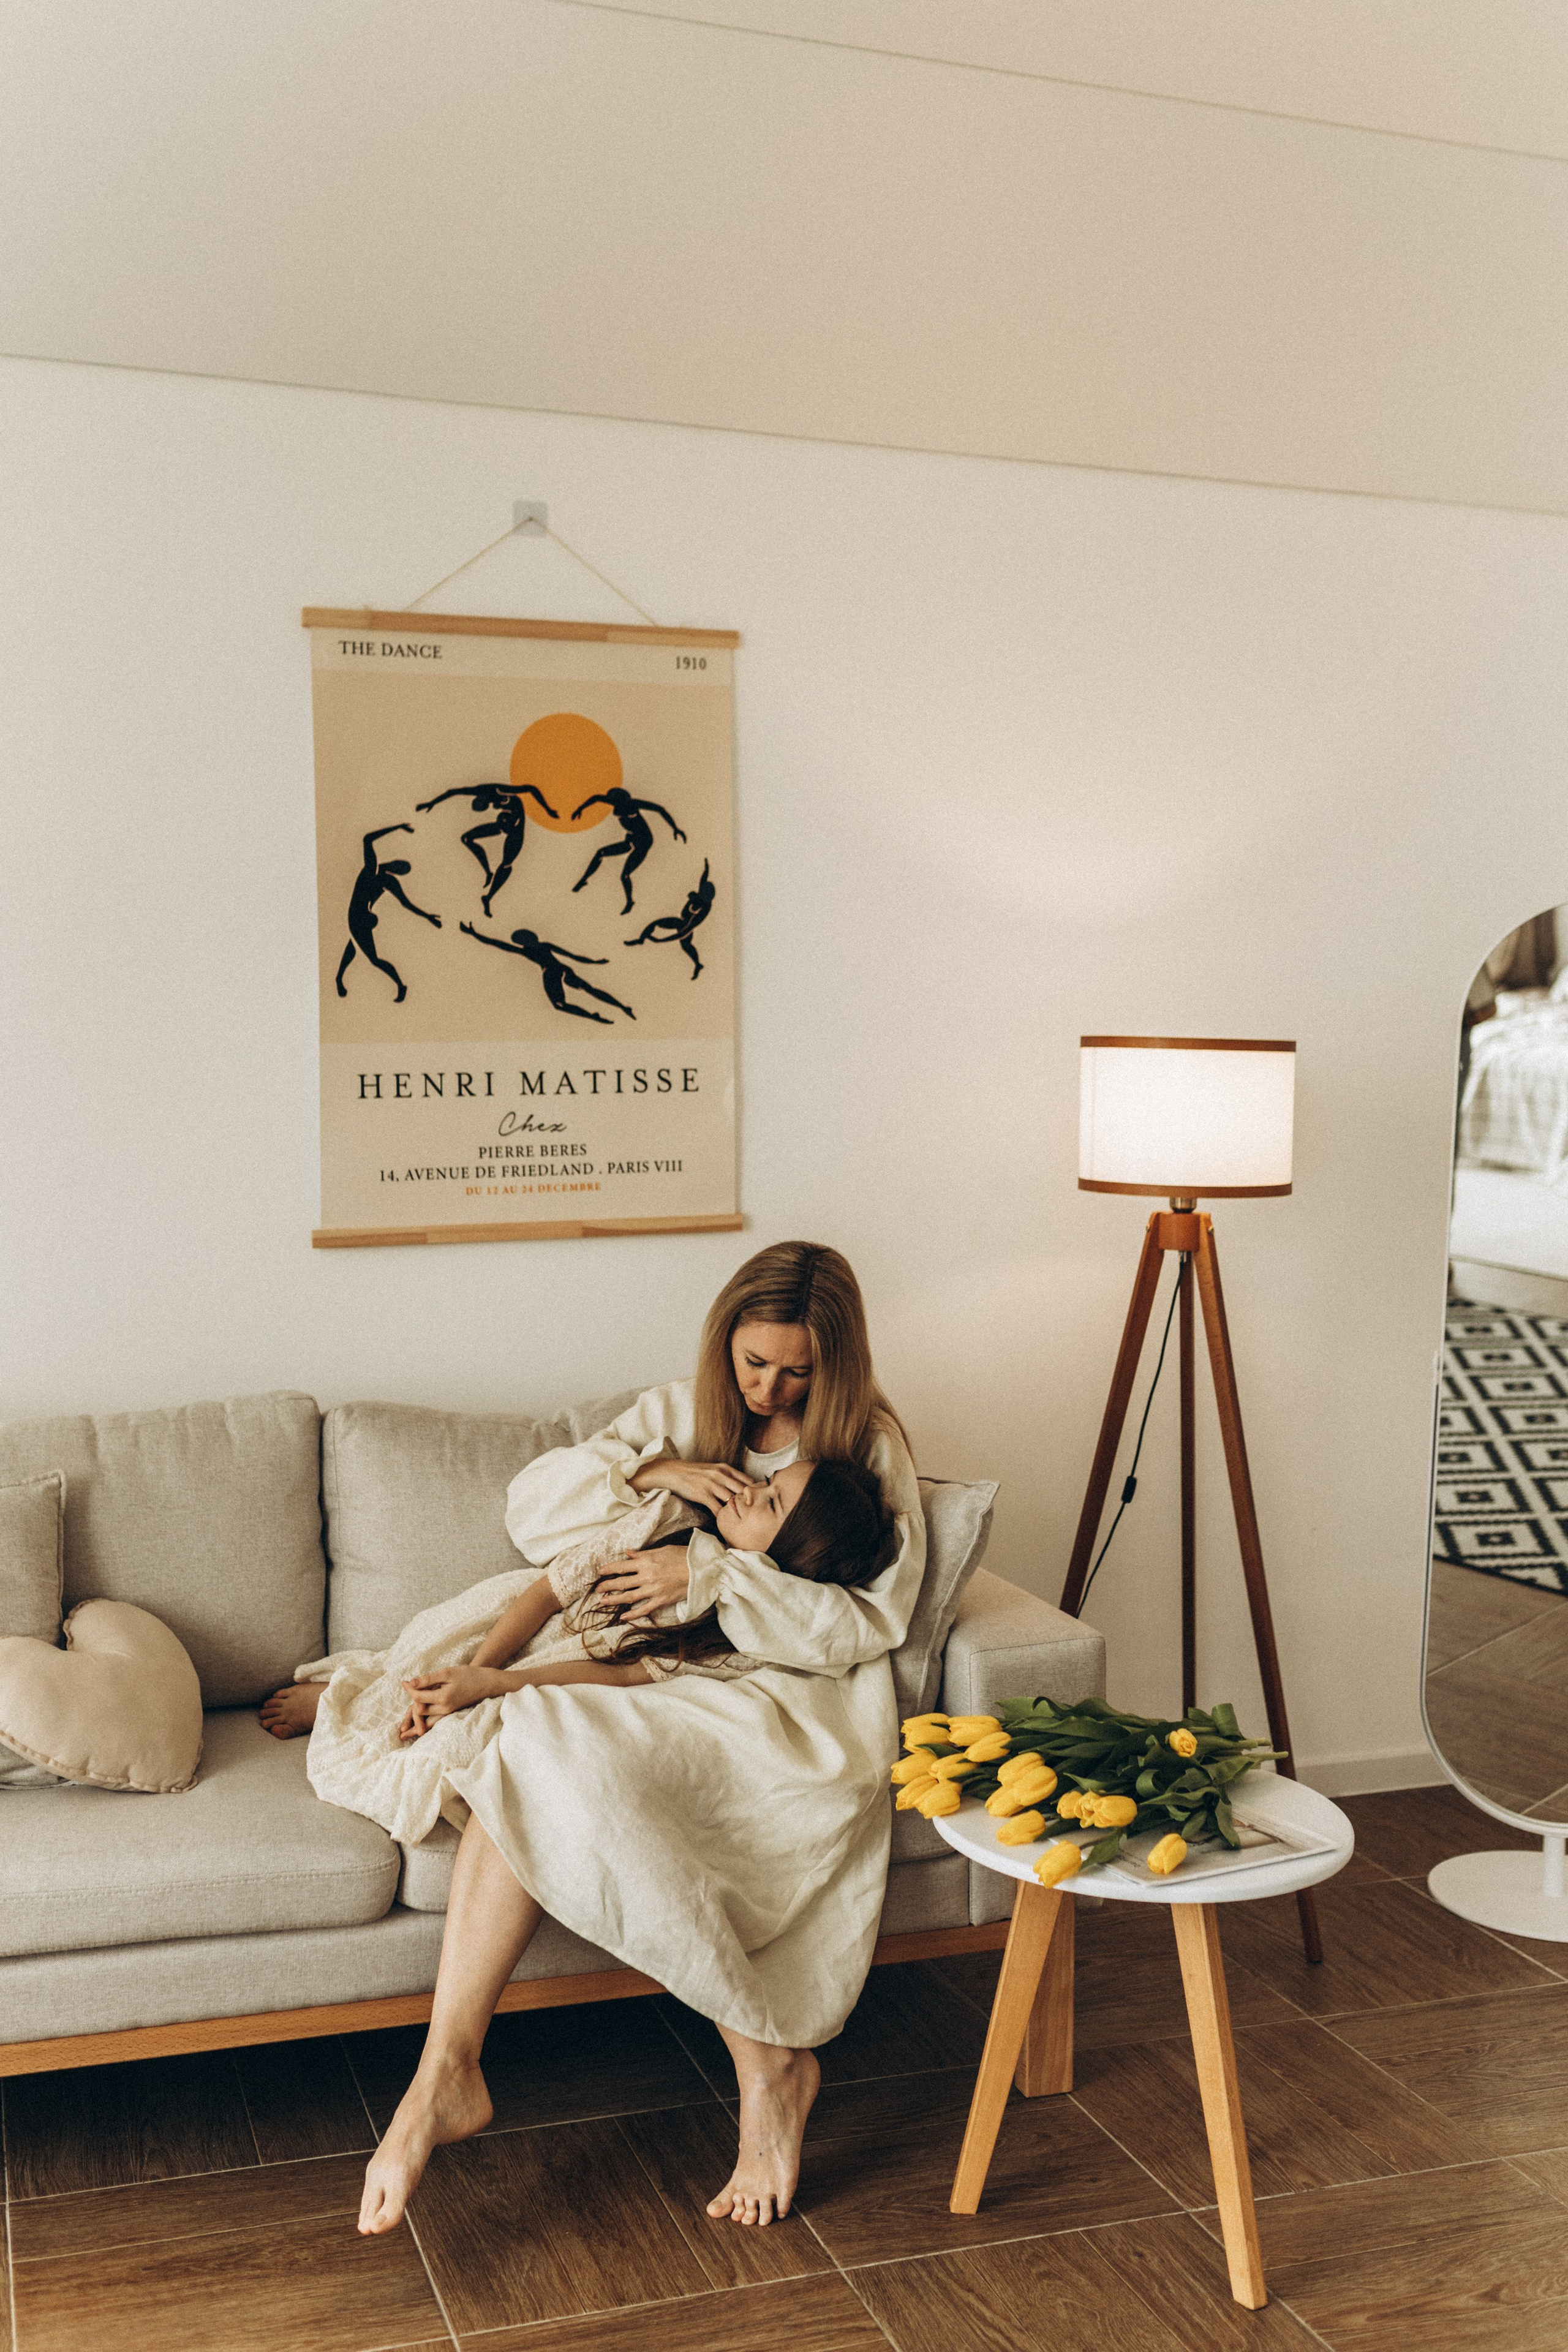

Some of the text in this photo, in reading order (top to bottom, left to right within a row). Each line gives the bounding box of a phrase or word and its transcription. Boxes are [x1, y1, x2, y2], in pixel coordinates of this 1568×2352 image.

[338, 640, 442, 660] THE DANCE
[676, 655, 707, 670] 1910
[358, 1068, 699, 1099] HENRI MATISSE
[499, 1111, 567, 1137] Chez
[478, 1143, 587, 1159] PIERRE BERES
[380, 1170, 399, 1182] 14,
[404, 1166, 470, 1182] AVENUE
[475, 1165, 496, 1179] DE
[502, 1162, 594, 1178] FRIEDLAND
[608, 1160, 649, 1175] PARIS
[654, 1159, 683, 1172] VIII
[466, 1186, 481, 1195] DU
[502, 1185, 518, 1194] AU
[537, 1182, 601, 1193] DECEMBRE
